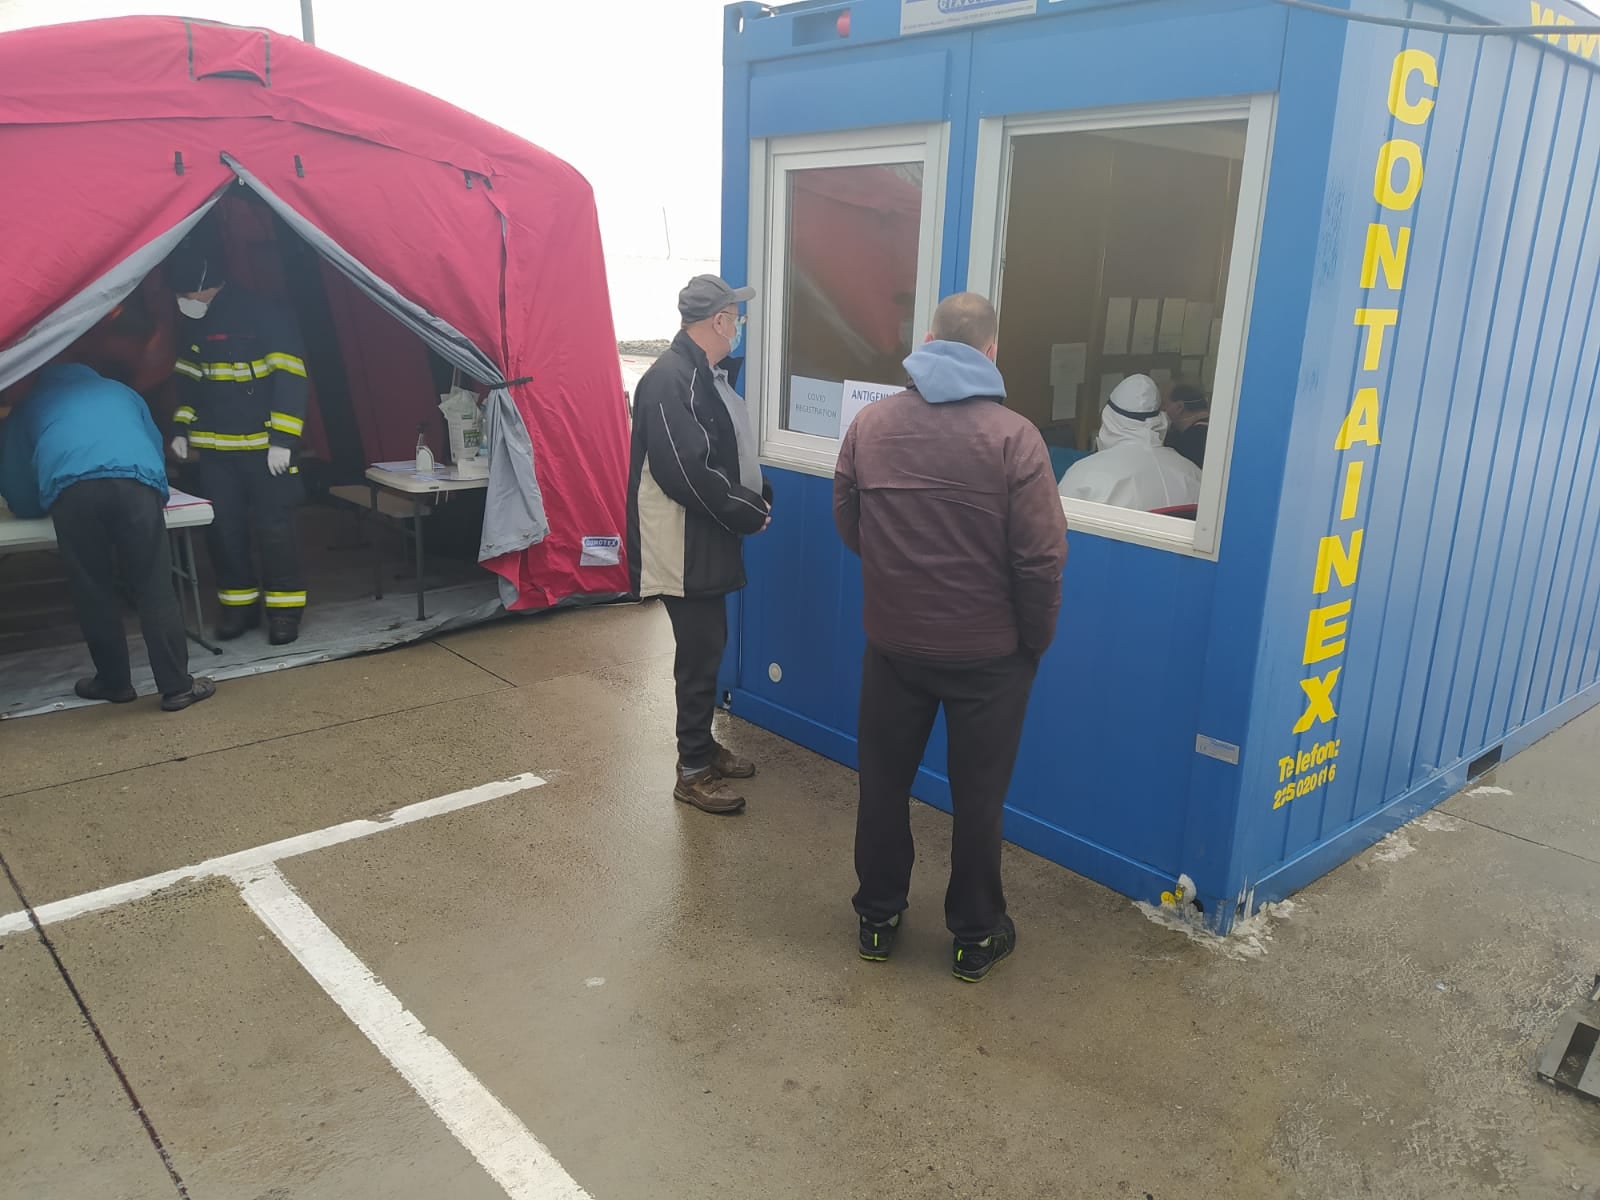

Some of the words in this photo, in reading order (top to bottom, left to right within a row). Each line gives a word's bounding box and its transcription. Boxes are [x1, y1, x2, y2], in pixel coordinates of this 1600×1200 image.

[807, 392, 826, 402] COVID
[851, 389, 896, 402] ANTIGEN
[1292, 49, 1439, 735] CONTAINEX
[795, 404, 838, 418] REGISTRATION
